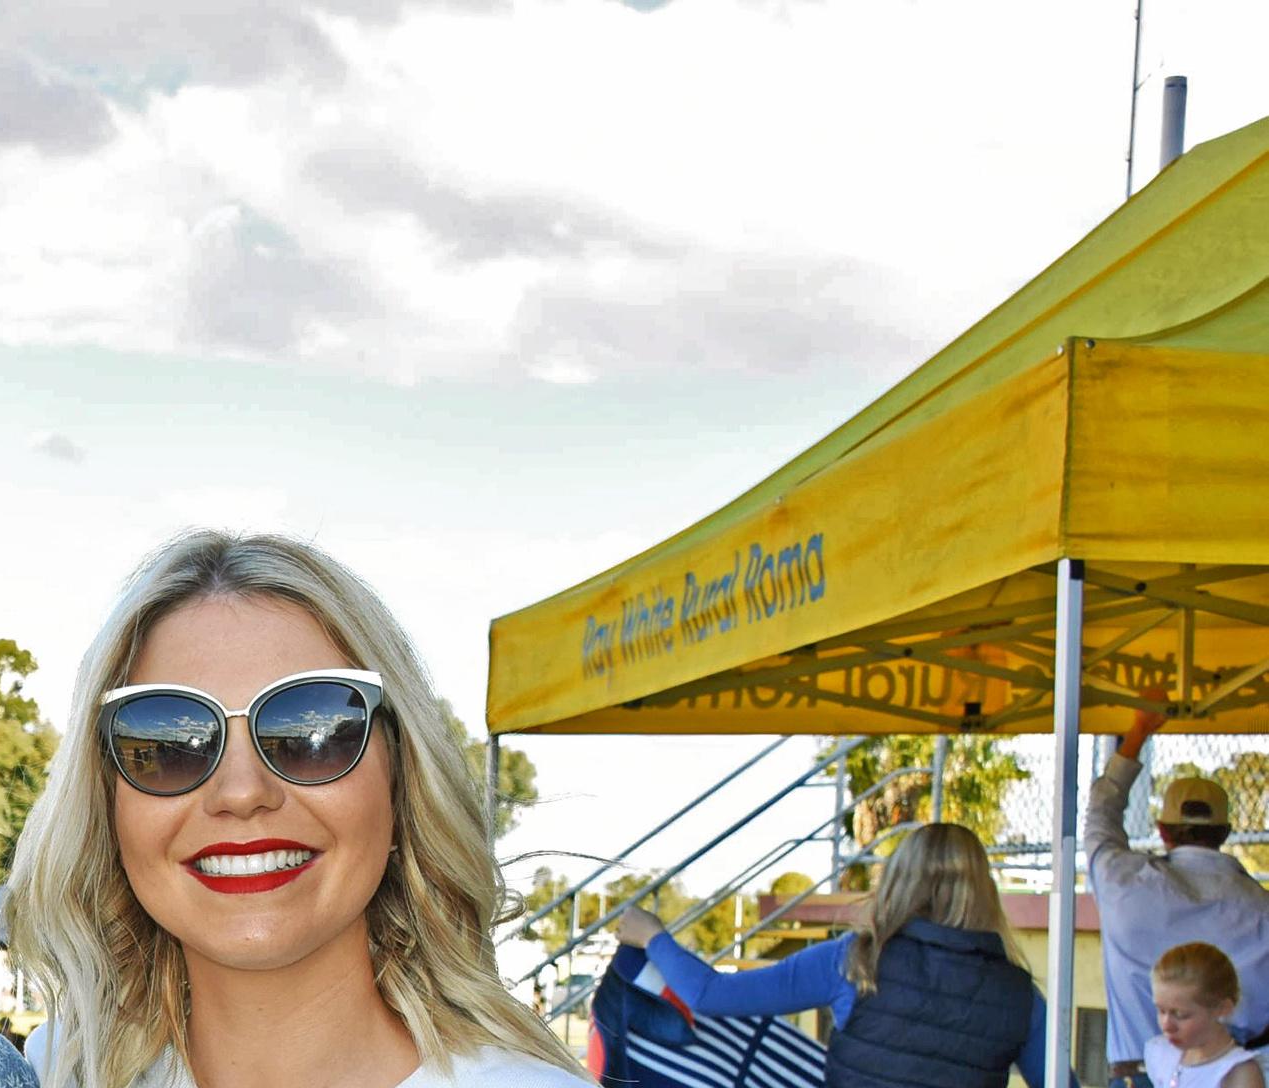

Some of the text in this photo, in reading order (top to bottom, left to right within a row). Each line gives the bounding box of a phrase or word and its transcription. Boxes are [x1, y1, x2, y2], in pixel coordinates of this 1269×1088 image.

[583, 533, 826, 689] Ray White Rural Roma
